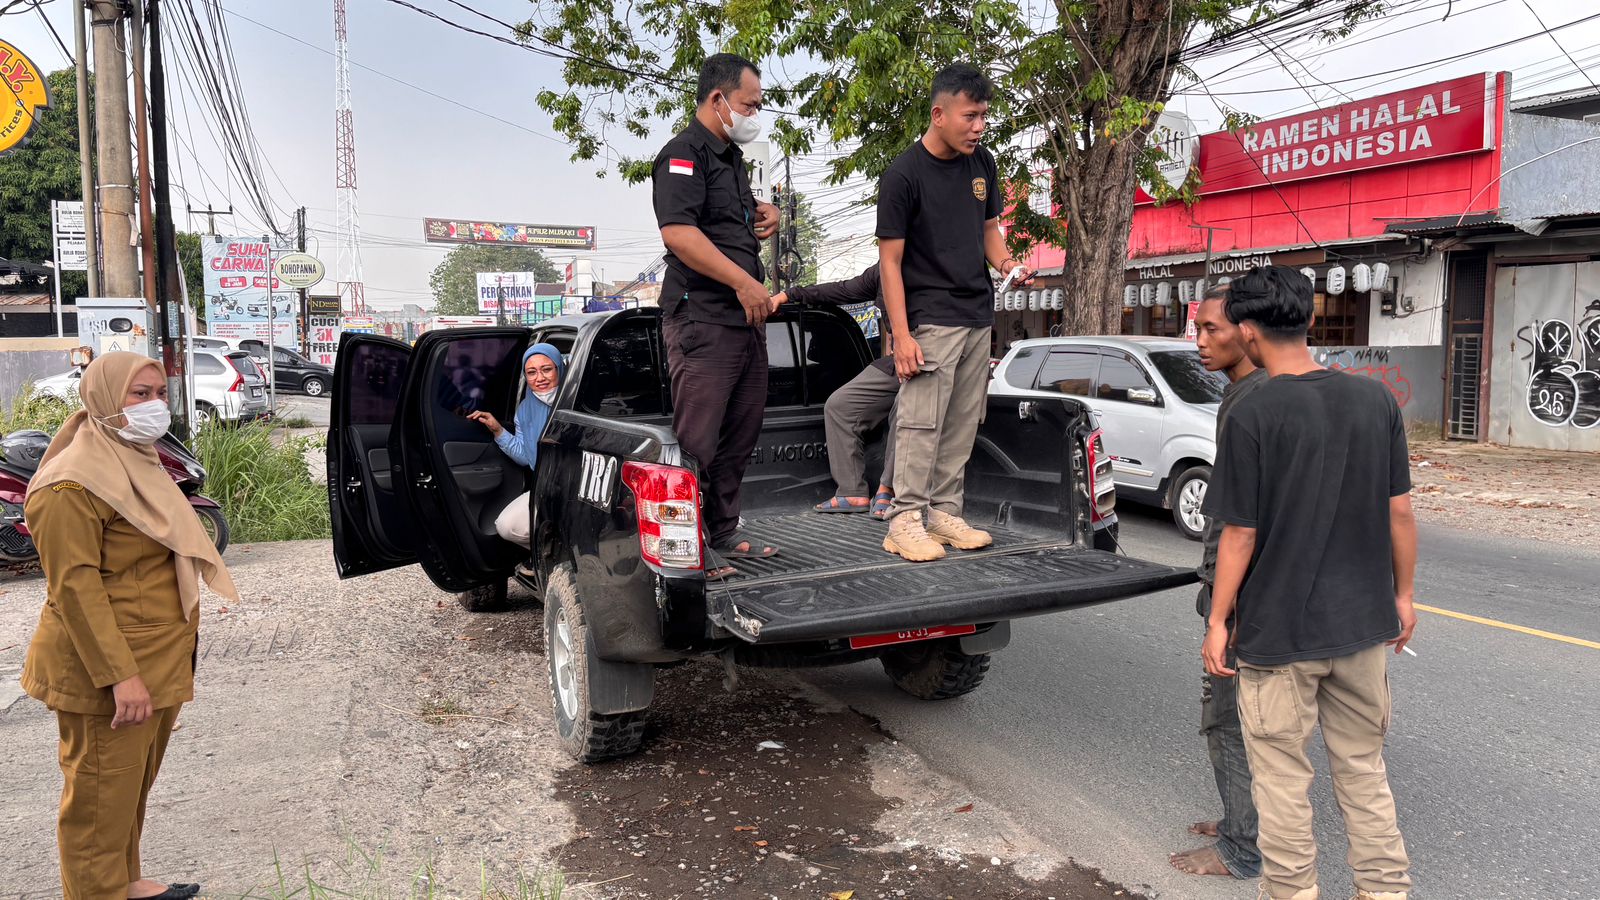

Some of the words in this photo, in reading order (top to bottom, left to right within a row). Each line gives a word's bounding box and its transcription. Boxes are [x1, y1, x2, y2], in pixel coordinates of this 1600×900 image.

[1243, 114, 1340, 153] RAMEN
[1350, 91, 1461, 133] HALAL
[1262, 125, 1433, 175] INDONESIA
[280, 263, 317, 275] BOHOPANNA
[1139, 265, 1174, 280] HALAL
[311, 318, 339, 326] CUCI
[312, 342, 338, 353] FREE
